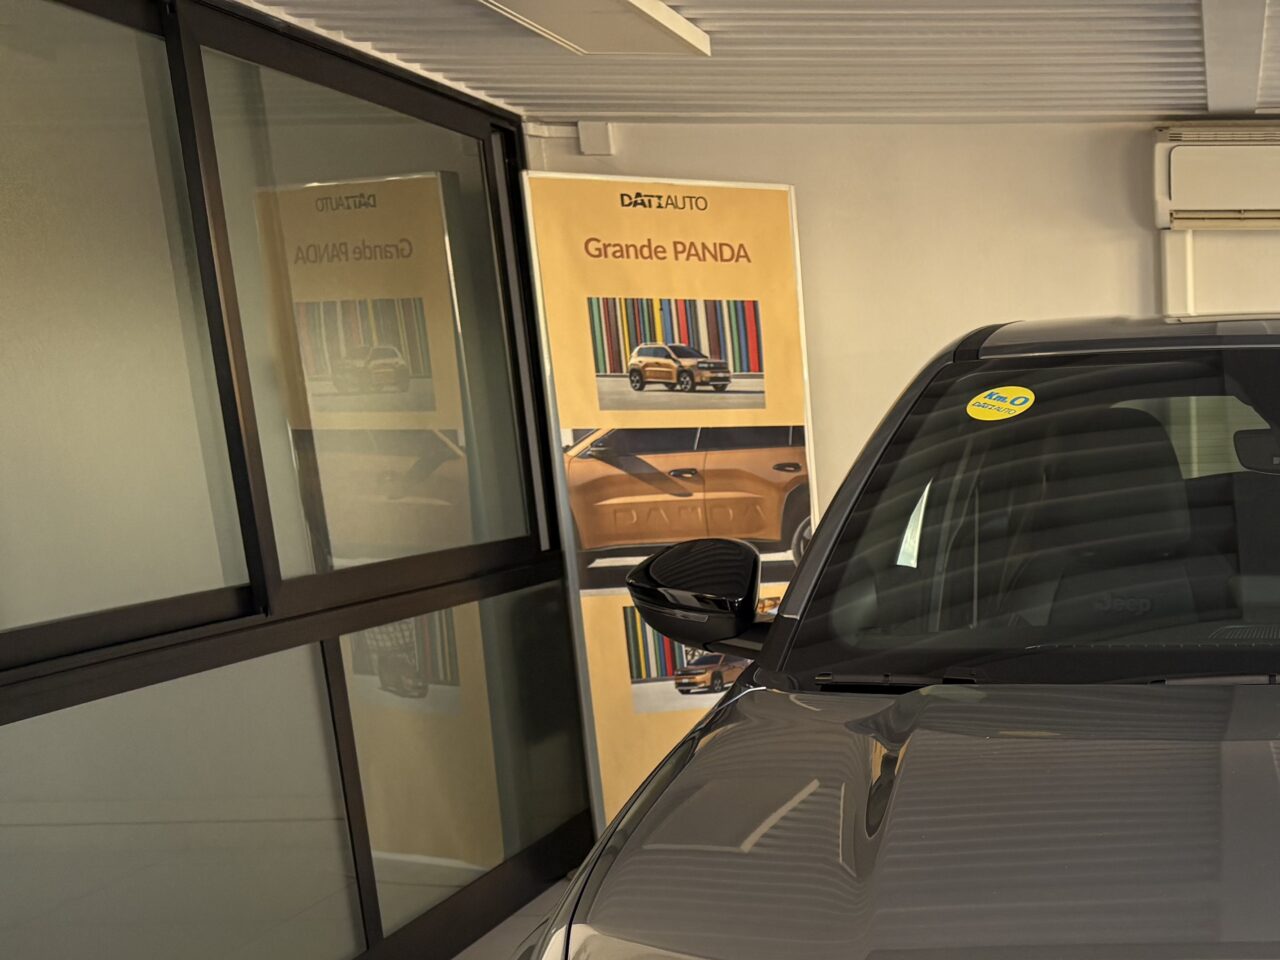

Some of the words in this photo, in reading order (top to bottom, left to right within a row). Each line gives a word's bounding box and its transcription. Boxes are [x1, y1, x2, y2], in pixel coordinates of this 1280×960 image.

[620, 192, 708, 211] DATIAUTO
[584, 237, 667, 260] Grande
[673, 241, 752, 263] PANDA
[1093, 592, 1151, 615] Jeep
